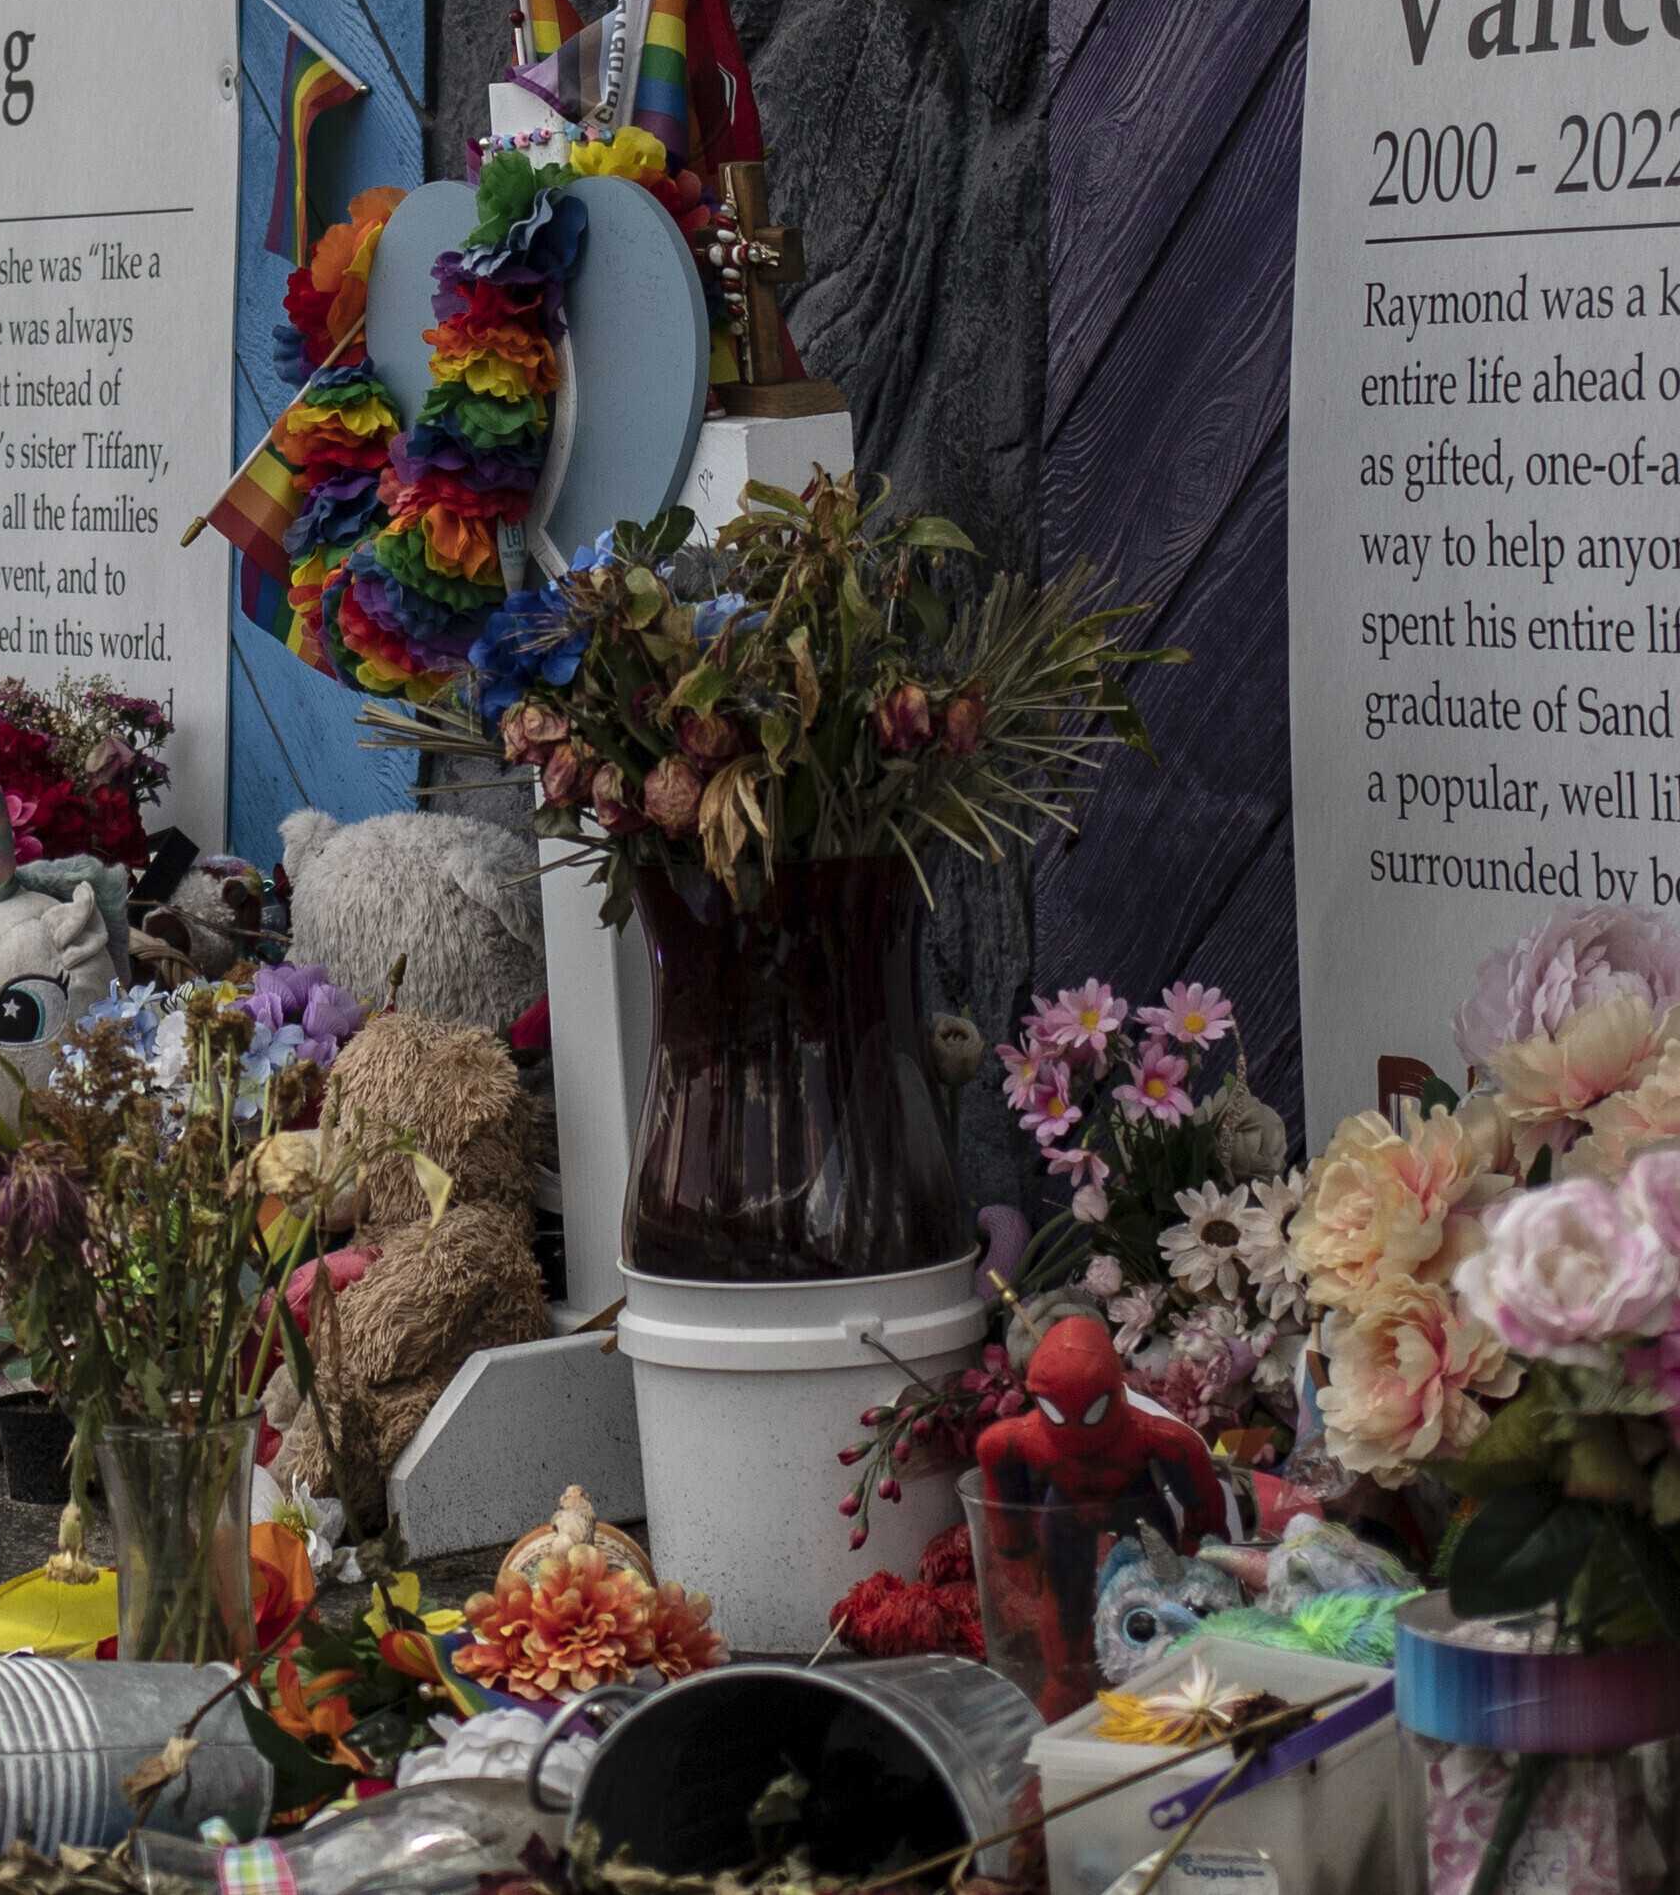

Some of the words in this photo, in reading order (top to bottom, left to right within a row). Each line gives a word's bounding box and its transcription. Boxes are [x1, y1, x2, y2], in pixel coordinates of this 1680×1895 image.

[1369, 122, 1497, 207] 2000
[0, 248, 33, 285] she
[39, 256, 82, 282] was
[89, 242, 142, 280] “like
[9, 320, 49, 345] was
[56, 307, 133, 356] always
[1363, 273, 1528, 343] Raymond
[1540, 285, 1614, 320] was
[16, 369, 91, 406] instead
[1361, 360, 1457, 407] entire
[1467, 355, 1522, 404] life
[1533, 351, 1645, 403] ahead
[21, 437, 76, 469] sister
[82, 430, 169, 483] Tiffany,
[1405, 437, 1514, 502] gifted,
[2, 493, 26, 529] all
[33, 493, 65, 531] the
[72, 493, 158, 533] families
[57, 557, 97, 594] and
[1360, 533, 1432, 582] way
[1486, 519, 1565, 584] help
[55, 618, 93, 657] this
[100, 621, 172, 662] world.
[1362, 606, 1455, 660] spent
[1464, 600, 1517, 649] his
[1528, 605, 1635, 653] entire
[1365, 679, 1521, 740] graduate
[1578, 686, 1674, 738] Sand
[1396, 763, 1548, 823] popular,
[1559, 770, 1639, 820] well
[1370, 849, 1582, 898] surrounded
